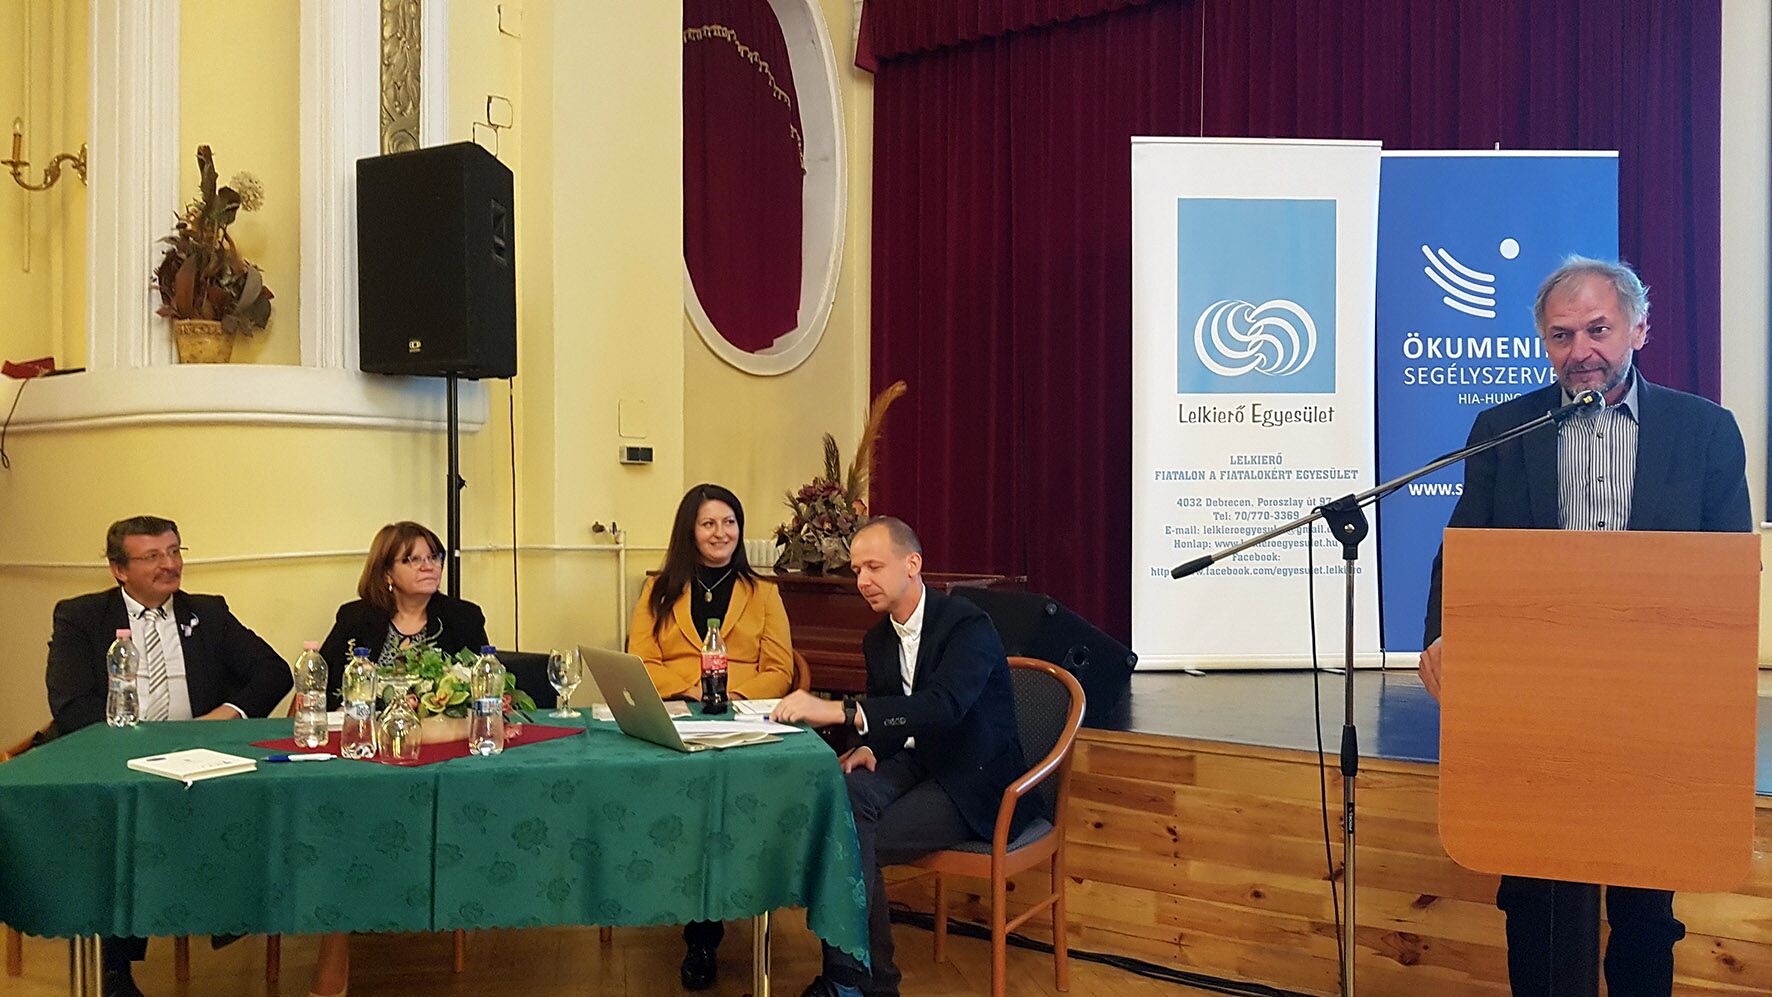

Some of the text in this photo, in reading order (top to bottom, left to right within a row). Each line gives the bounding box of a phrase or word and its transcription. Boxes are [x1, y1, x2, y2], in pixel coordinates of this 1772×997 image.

[1403, 332, 1549, 359] ÖKUMENI
[1179, 403, 1335, 427] Lelkierő Egyesület
[1230, 452, 1283, 465] LELKIERŐ
[1155, 467, 1359, 481] FIATALON A FIATALOKÉRT EGYESÜLET
[1176, 498, 1202, 507] 4032
[1257, 497, 1305, 509] Poroszlay
[1307, 496, 1316, 506] út
[1213, 511, 1300, 521] Tel: 70/770-3369
[1165, 525, 1200, 535] E-mail:
[1174, 539, 1211, 550] Honlap:
[1232, 552, 1281, 562] Facebook:
